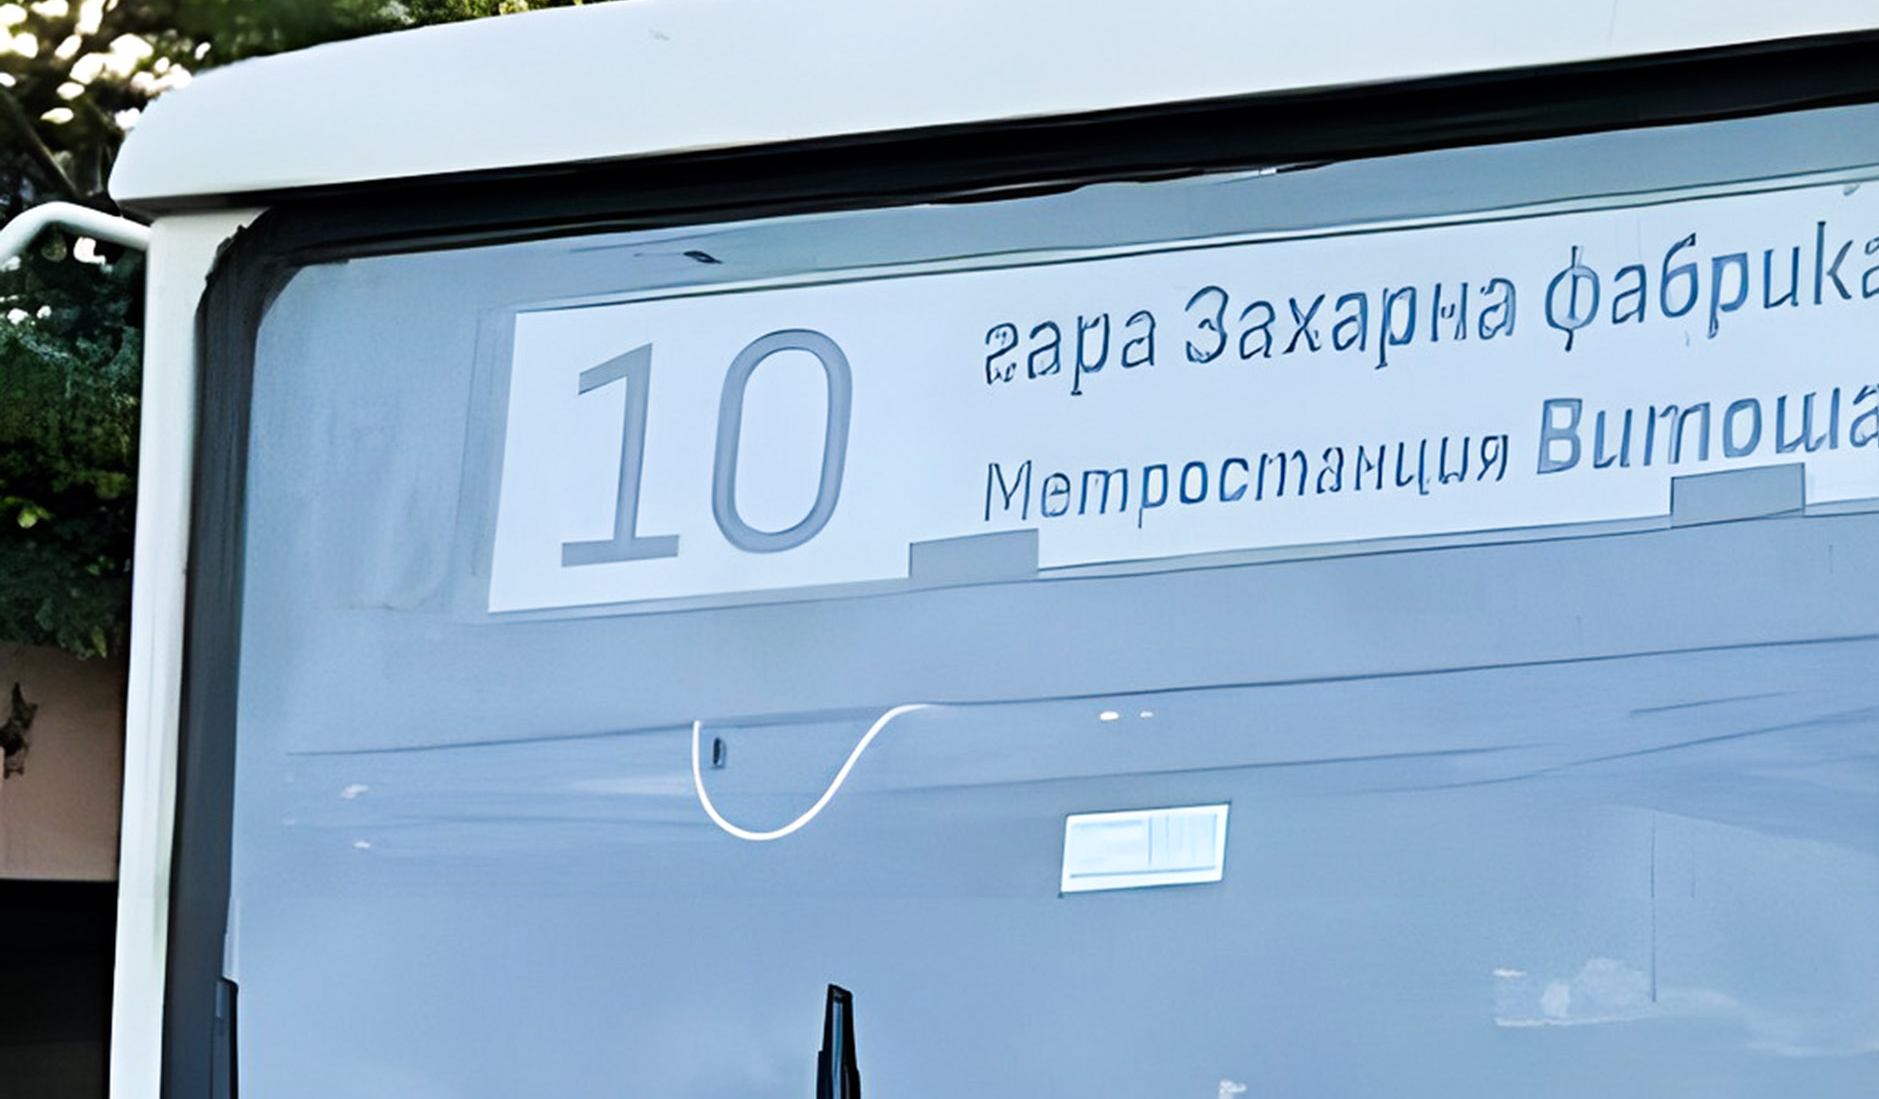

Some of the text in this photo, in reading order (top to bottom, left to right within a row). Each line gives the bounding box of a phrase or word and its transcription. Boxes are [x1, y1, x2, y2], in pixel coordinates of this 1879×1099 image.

[984, 310, 1157, 396] гара
[1184, 277, 1517, 369] Захарна
[561, 328, 853, 568] 10
[983, 432, 1510, 529] Метростанция
